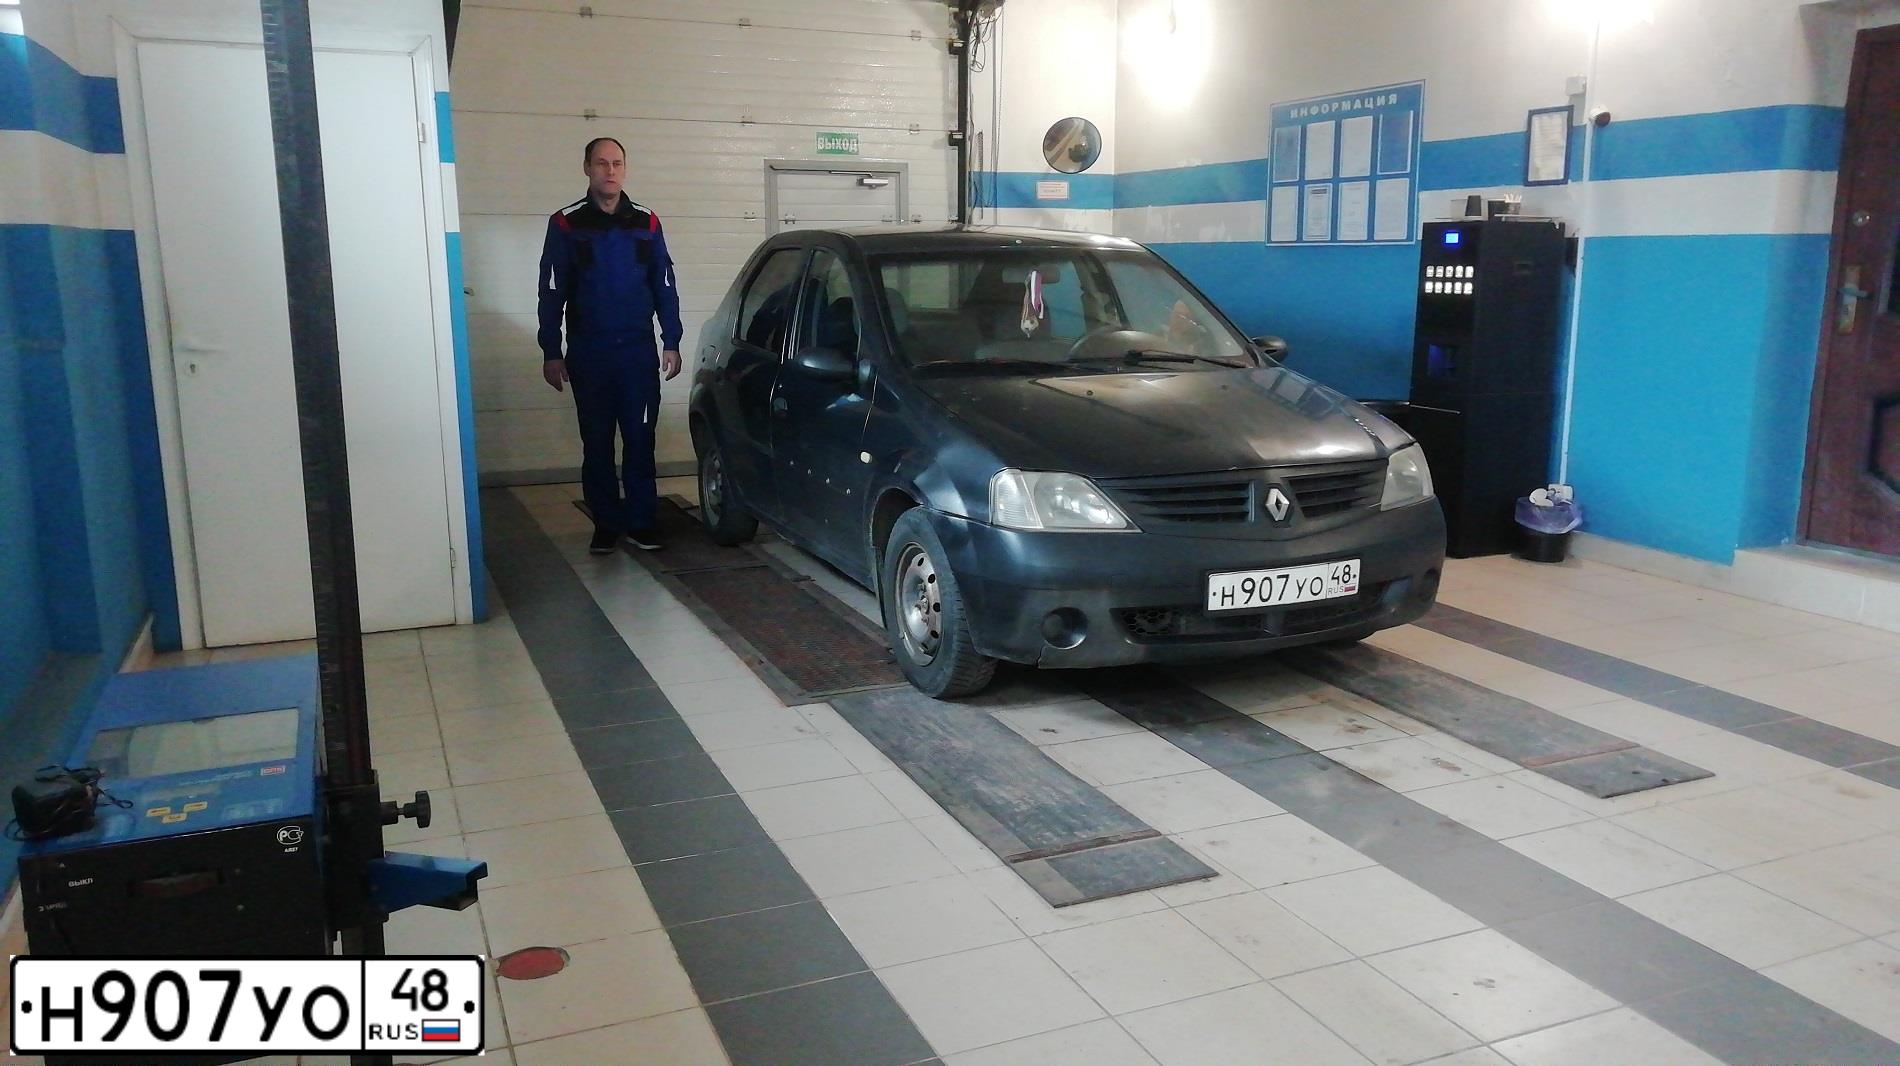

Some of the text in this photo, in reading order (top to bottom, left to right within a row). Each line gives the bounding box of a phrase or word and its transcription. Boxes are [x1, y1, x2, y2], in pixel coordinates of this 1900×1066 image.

[1290, 93, 1398, 118] ИНФОРМАЦИЯ
[817, 136, 859, 153] ВЫХОД
[1220, 564, 1351, 607] Н907УО 48
[1327, 586, 1344, 595] RUS
